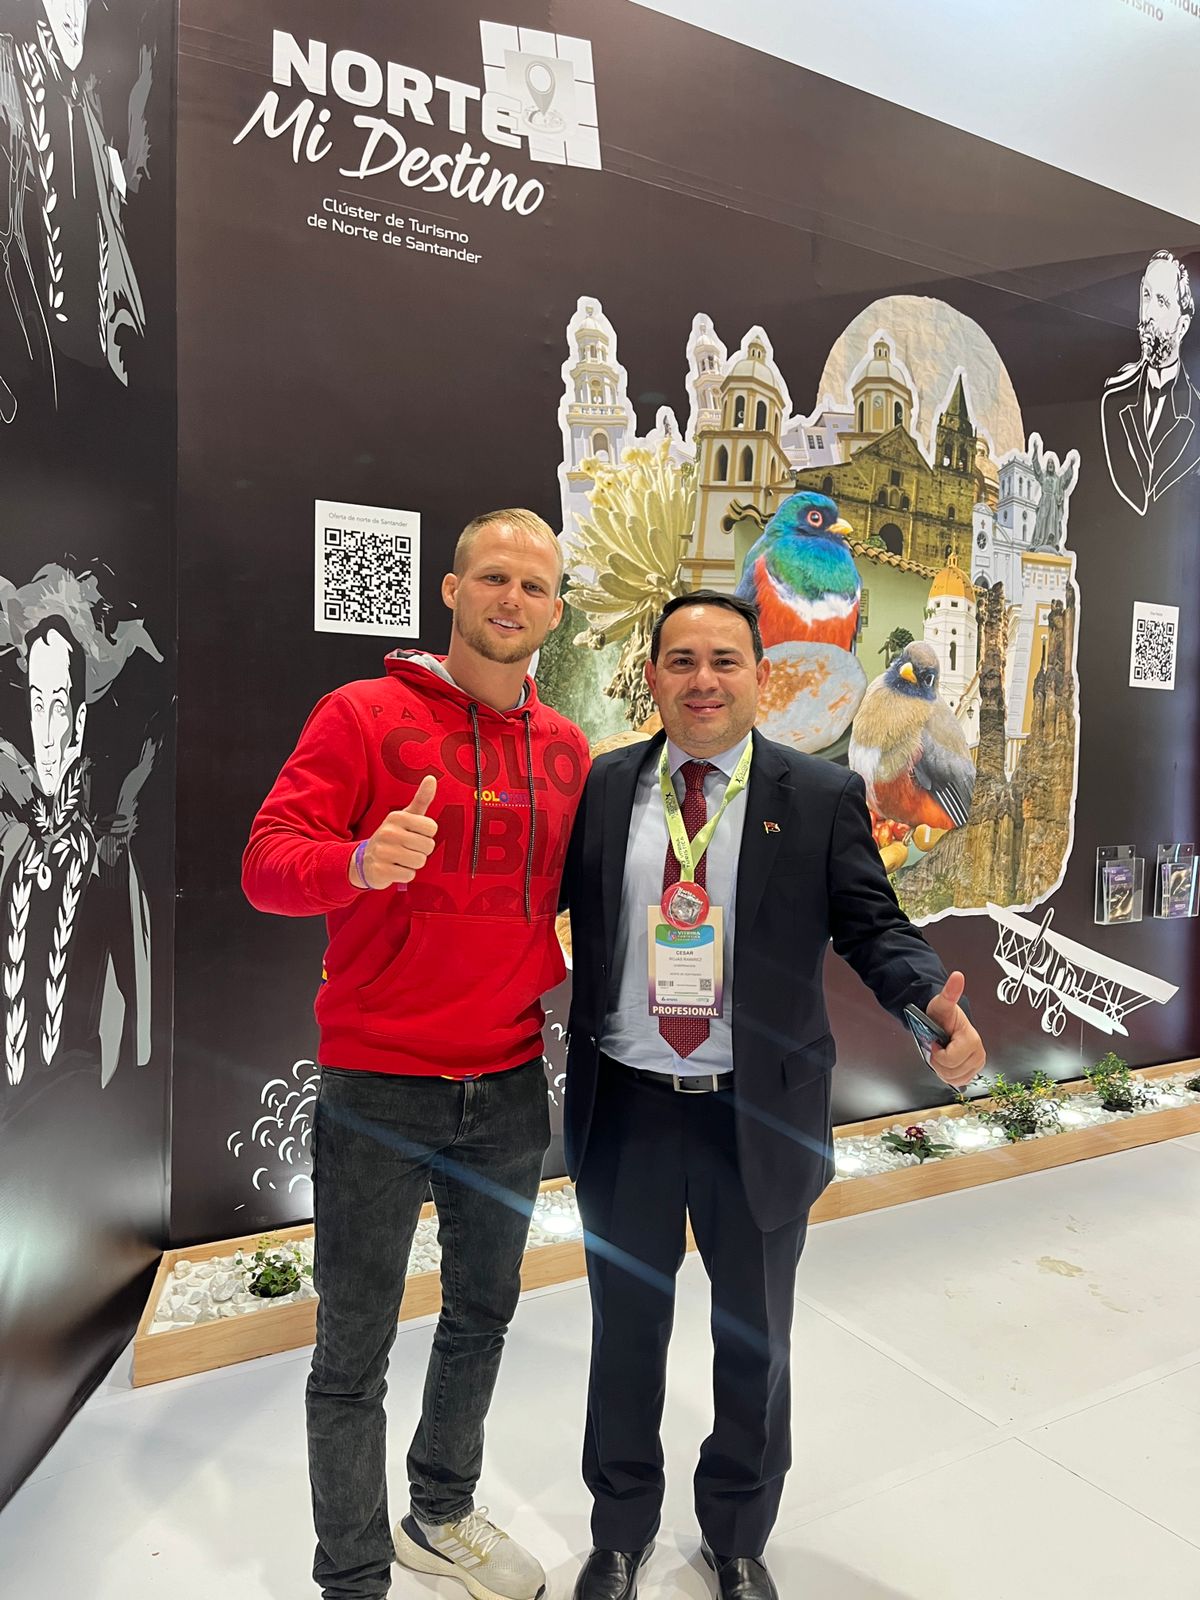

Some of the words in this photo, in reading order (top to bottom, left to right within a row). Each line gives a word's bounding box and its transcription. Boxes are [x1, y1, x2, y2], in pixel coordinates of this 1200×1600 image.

[273, 29, 522, 149] NORTE
[233, 91, 332, 163] Mi
[339, 115, 544, 216] Destino
[307, 213, 327, 230] de
[332, 219, 378, 241] Norte
[382, 230, 401, 247] de
[406, 235, 482, 265] Santander
[322, 197, 382, 222] Clúster
[385, 212, 404, 229] de
[409, 217, 469, 245] Turismo
[381, 727, 582, 796] COLO
[652, 1005, 719, 1016] PROFESIONAL
